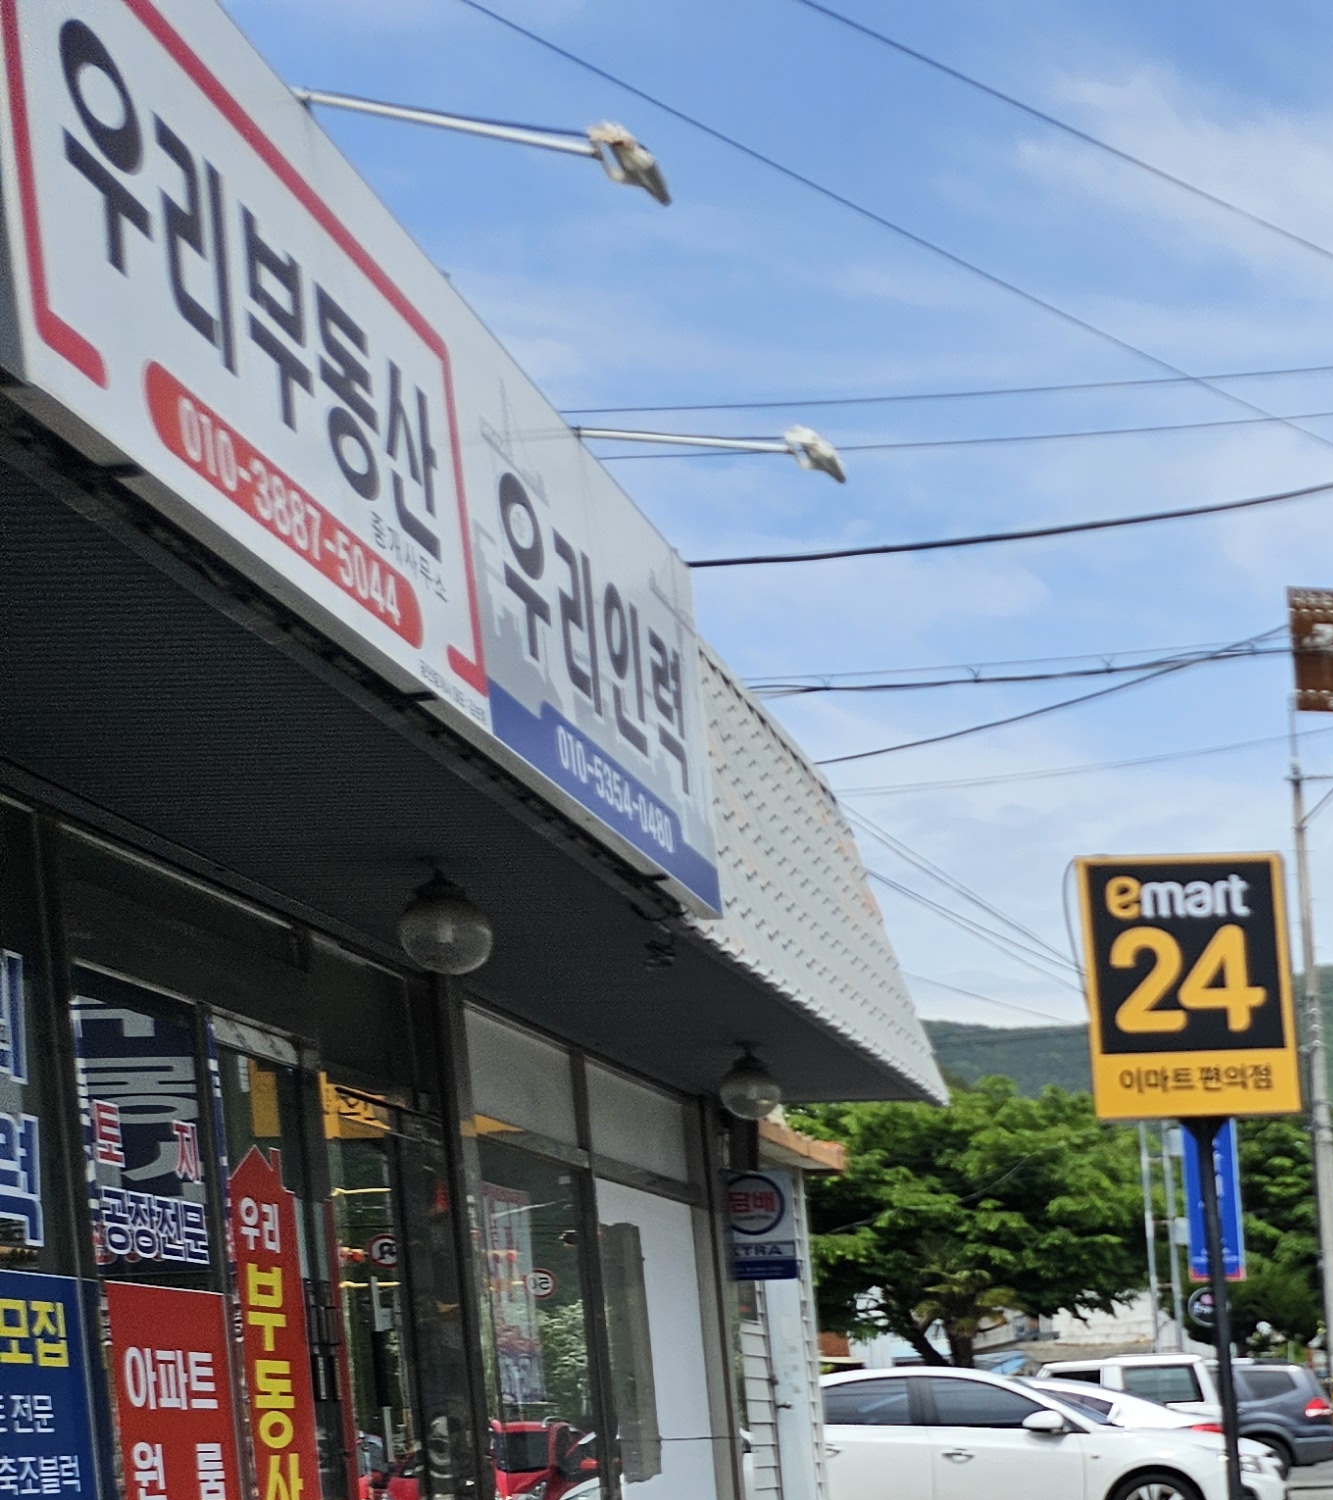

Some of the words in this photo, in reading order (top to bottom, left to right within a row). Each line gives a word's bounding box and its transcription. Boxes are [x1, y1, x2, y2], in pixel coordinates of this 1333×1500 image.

[58, 18, 441, 562] 우리부동산
[177, 397, 402, 626] 010-3887-5044
[498, 471, 690, 796] 우리인력
[556, 725, 674, 853] 010-5354-0480
[1105, 874, 1250, 920] emart
[1109, 923, 1267, 1034] 24
[1119, 1067, 1197, 1093] 이마트
[101, 1185, 210, 1265] 공장전문
[238, 1195, 281, 1254] 우리
[0, 1298, 70, 1368] 모집
[9, 1394, 56, 1434] 전문
[124, 1345, 219, 1411] 아파트
